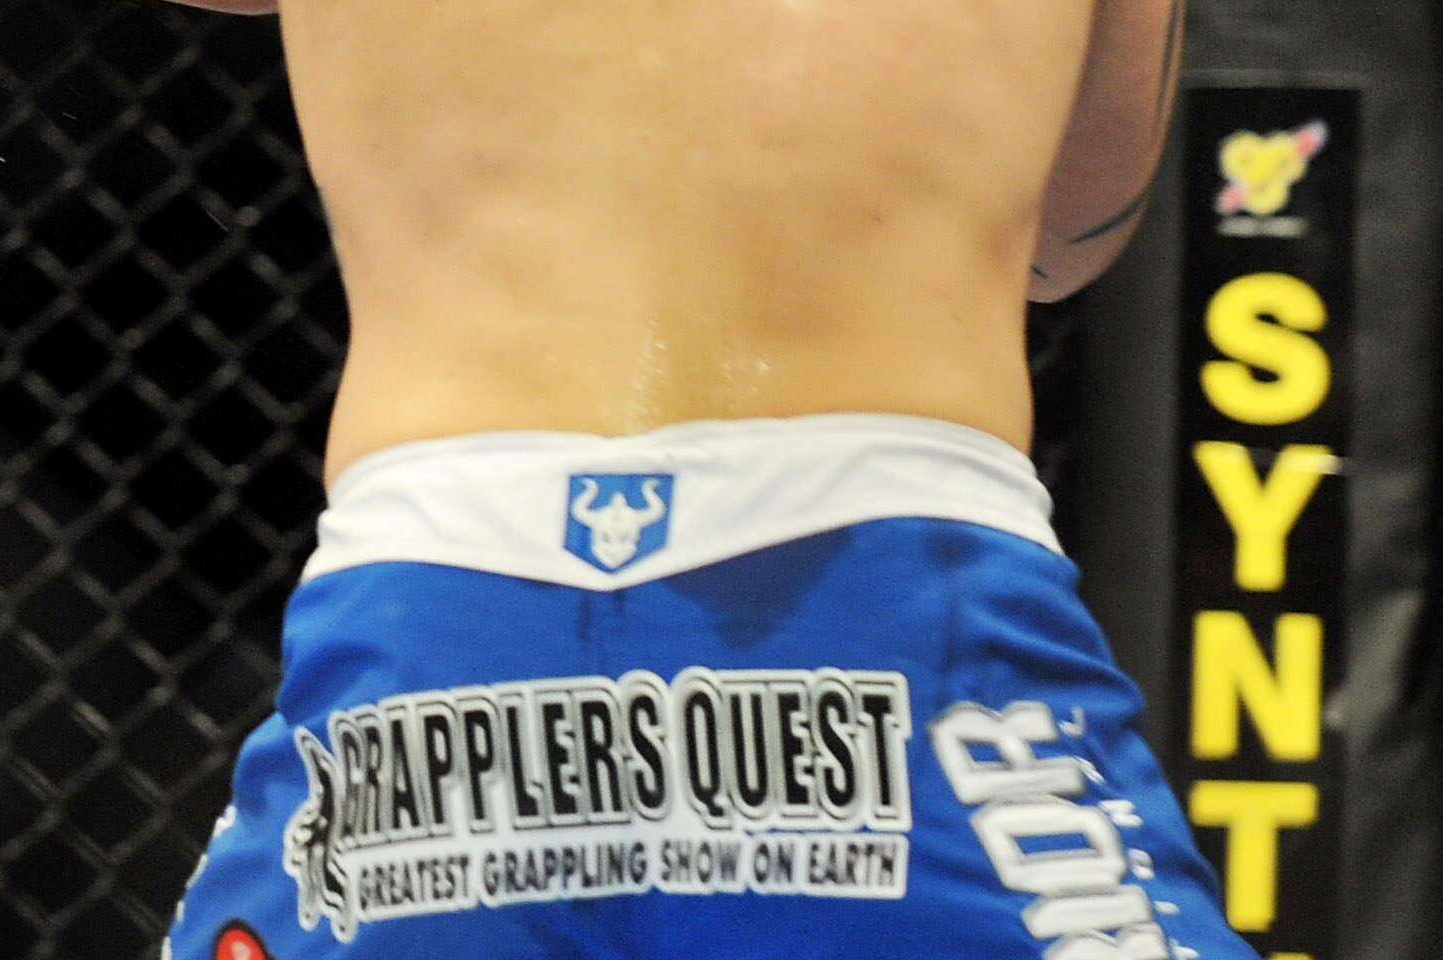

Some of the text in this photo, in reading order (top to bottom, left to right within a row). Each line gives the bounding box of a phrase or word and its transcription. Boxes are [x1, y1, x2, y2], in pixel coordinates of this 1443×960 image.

[1189, 271, 1332, 960] SYNT
[337, 685, 899, 840] GRAPPLERS QUEST
[357, 838, 898, 912] GREATEST GRAPPLING SHOW ON EARTH
